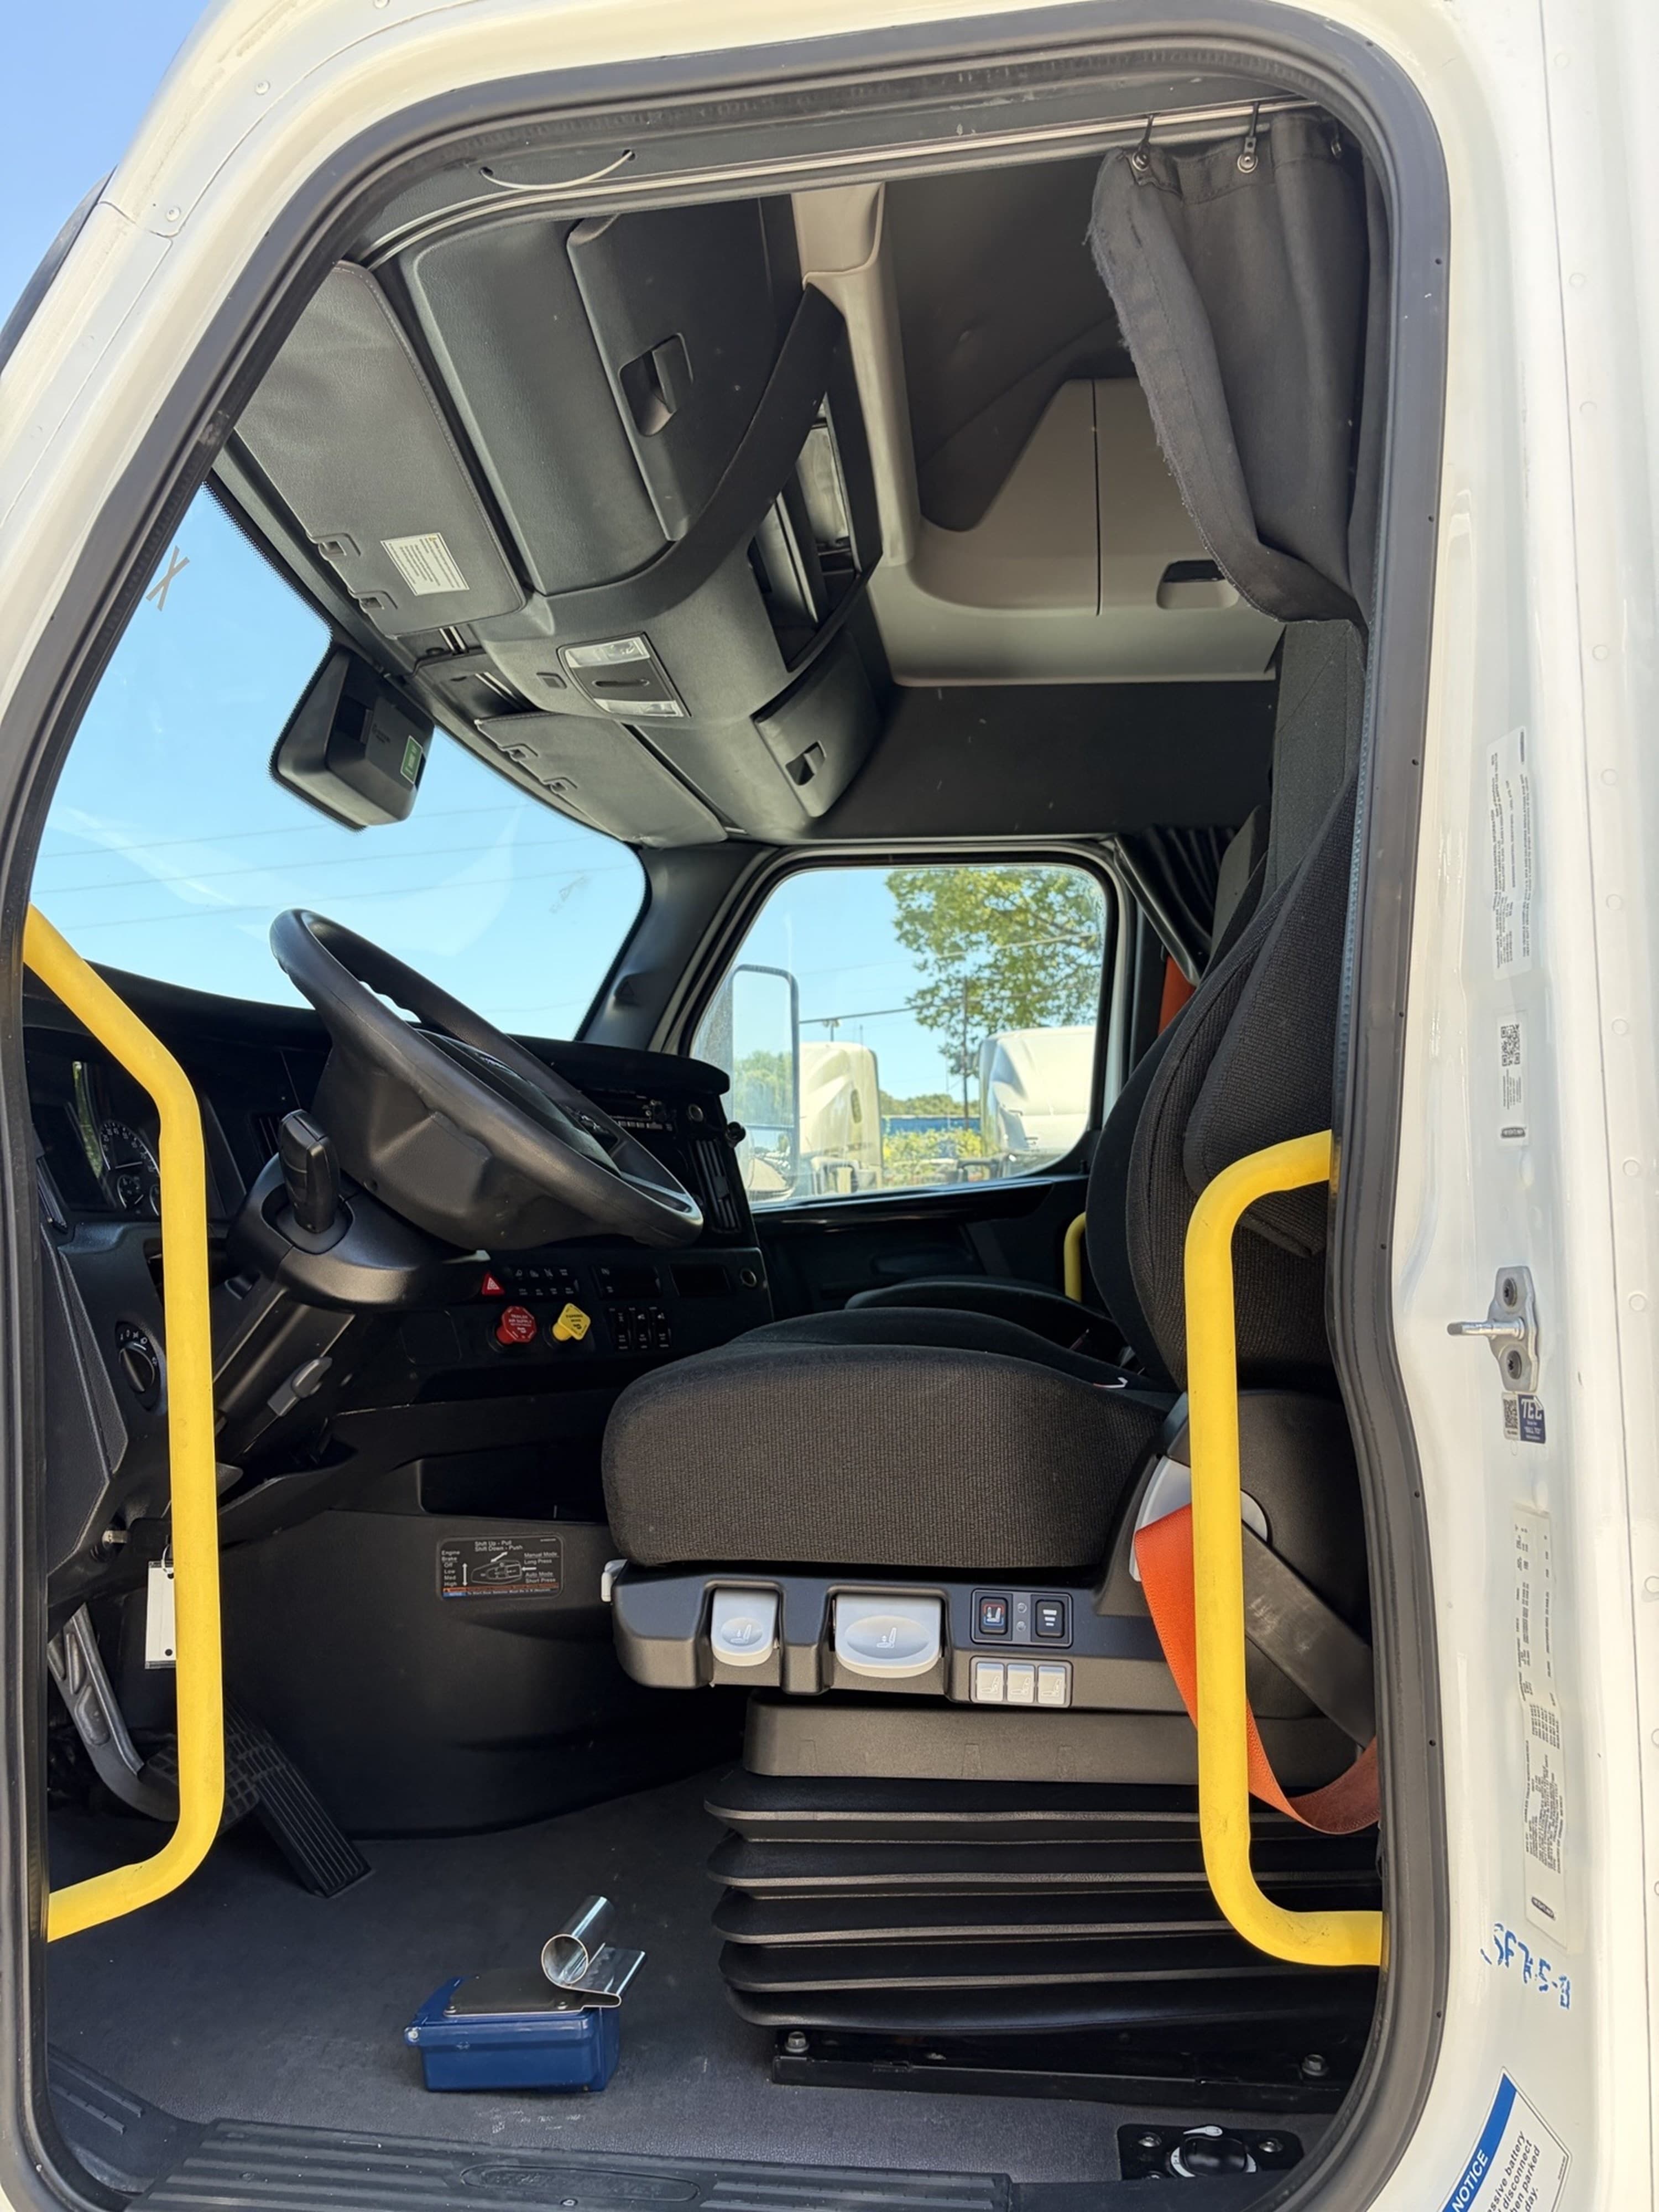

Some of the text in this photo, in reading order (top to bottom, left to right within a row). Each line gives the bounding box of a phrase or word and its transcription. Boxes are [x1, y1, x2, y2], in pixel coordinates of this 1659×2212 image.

[1503, 2140, 1532, 2210] disconnect
[1505, 2131, 1526, 2177] battery
[1522, 2145, 1541, 2193] parked
[1451, 2148, 1489, 2212] NOTICE
[1524, 2188, 1539, 2212] day.
